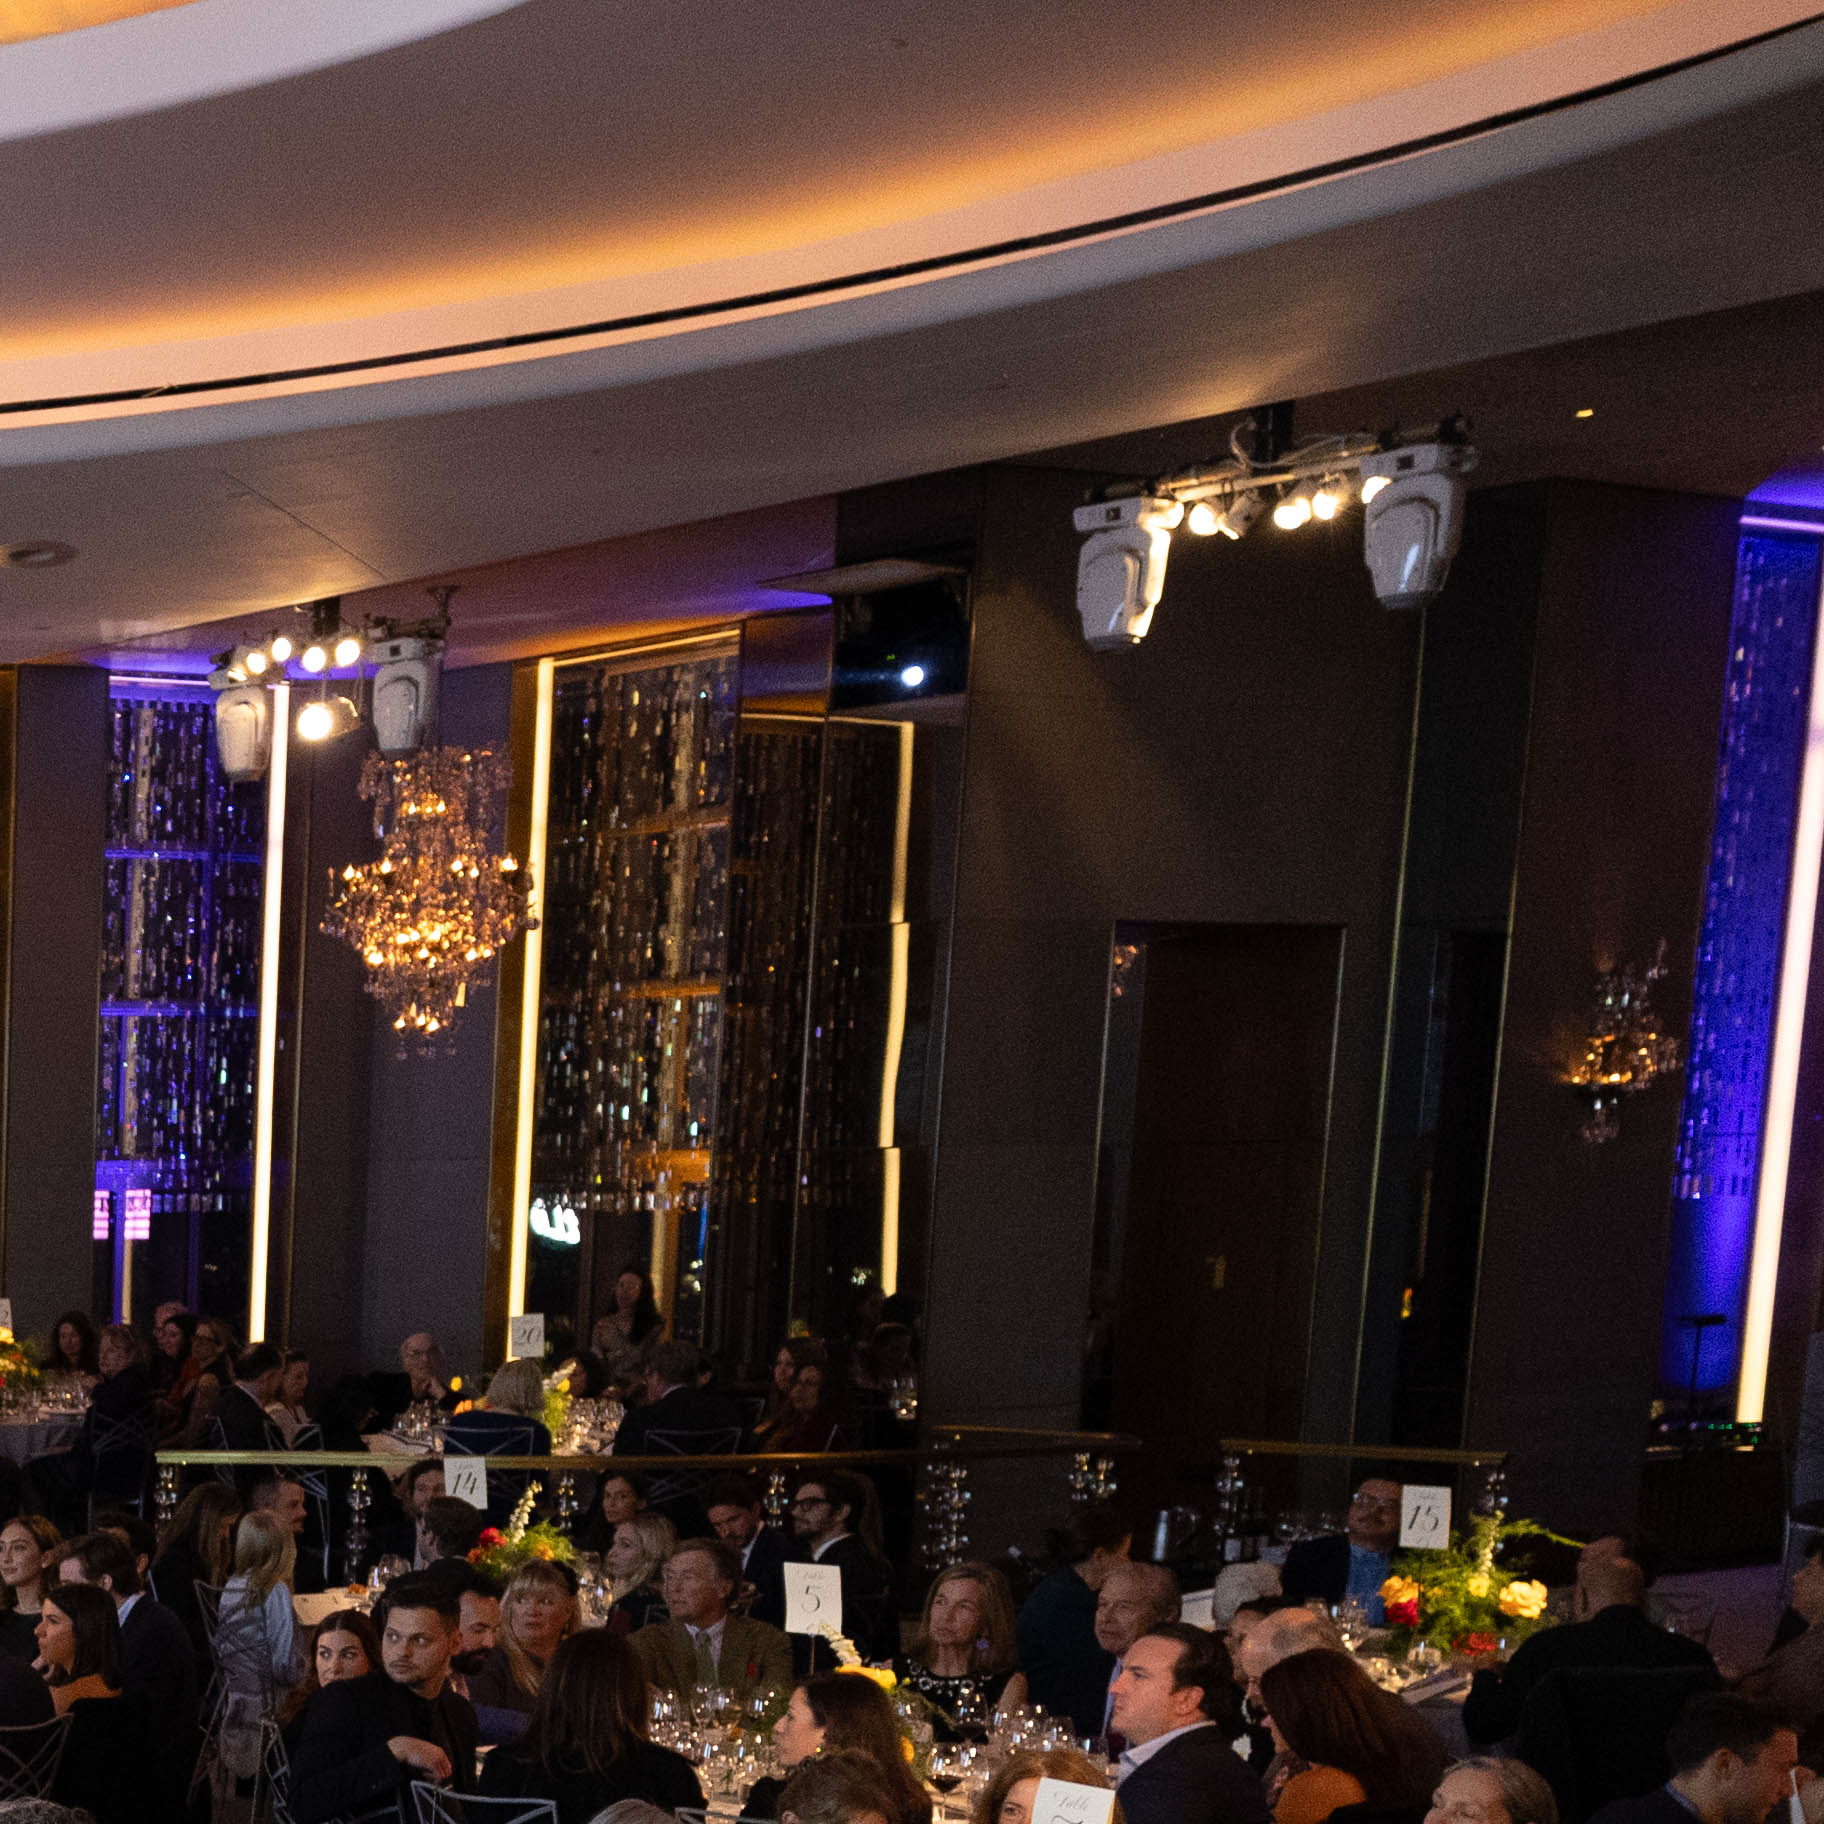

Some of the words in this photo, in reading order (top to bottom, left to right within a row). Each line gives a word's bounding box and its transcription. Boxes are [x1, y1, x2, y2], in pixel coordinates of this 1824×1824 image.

[519, 1327, 542, 1345] 20
[452, 1471, 478, 1495] 14
[1407, 1504, 1441, 1533] 15
[801, 1585, 823, 1614] 5
[1052, 1792, 1089, 1811] Table
